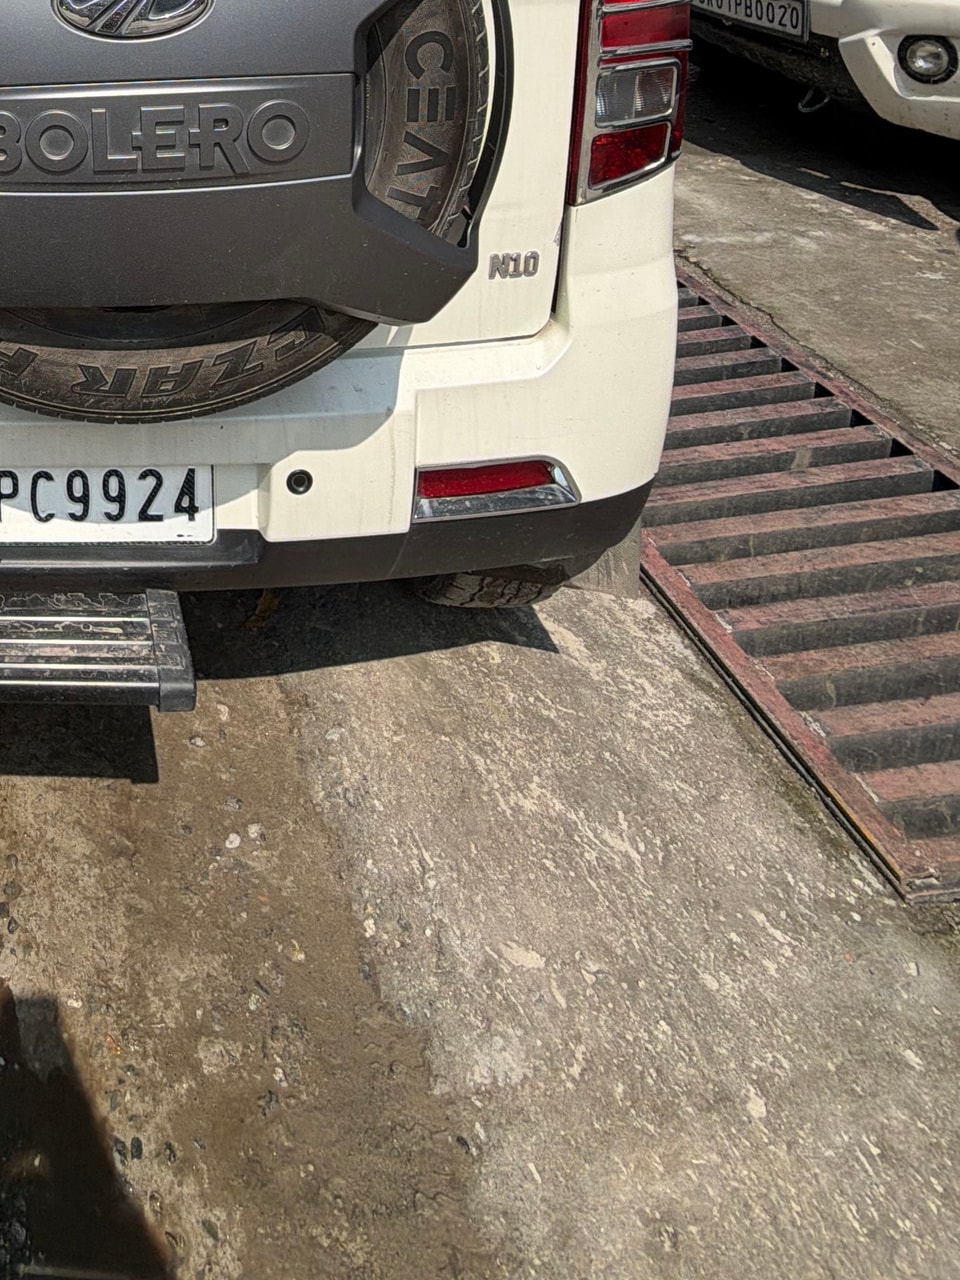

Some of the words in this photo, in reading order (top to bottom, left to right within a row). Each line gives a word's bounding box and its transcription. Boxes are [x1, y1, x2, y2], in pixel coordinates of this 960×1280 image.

[386, 30, 456, 221] CEAT
[488, 250, 540, 280] N10
[70, 305, 327, 398] CZAR
